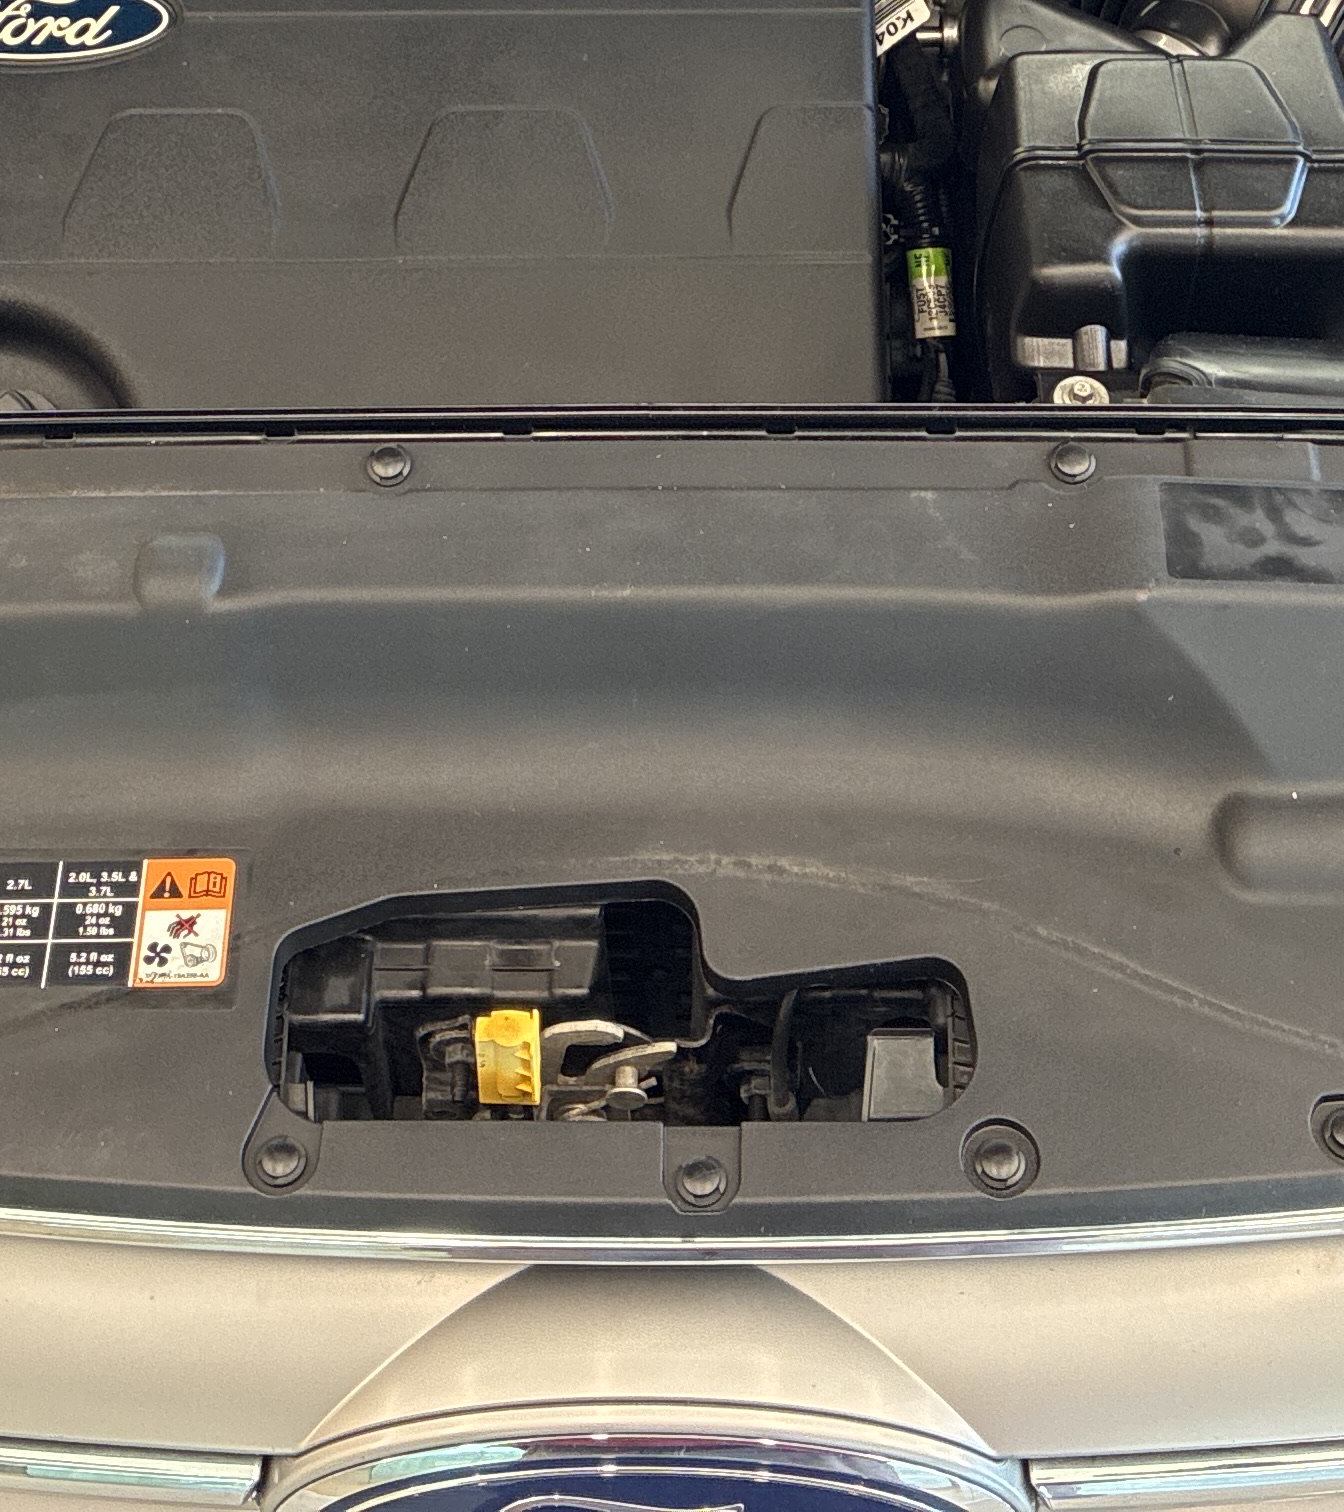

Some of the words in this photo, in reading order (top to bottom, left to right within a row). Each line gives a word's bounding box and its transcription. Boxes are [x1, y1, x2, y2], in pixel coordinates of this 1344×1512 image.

[68, 871, 97, 883] 2.0L,
[100, 871, 126, 882] 3.5L
[129, 871, 138, 882] &
[6, 879, 32, 890] 2.7L
[88, 886, 114, 897] 3.7L
[25, 904, 40, 918] kg
[75, 903, 106, 915] 0.680
[108, 903, 123, 917] kg
[1, 917, 13, 926] 21
[15, 918, 28, 926] oz
[85, 916, 97, 925] 24
[98, 917, 110, 925] oz
[16, 927, 31, 936] lbs
[99, 926, 114, 935] lbs
[5, 953, 14, 963] fl
[15, 954, 30, 963] oz
[69, 952, 87, 963] 5.2
[89, 952, 98, 962] fl
[100, 953, 114, 962] oz
[11, 966, 30, 978] cc)
[68, 965, 93, 978] (155
[95, 964, 114, 977] cc)
